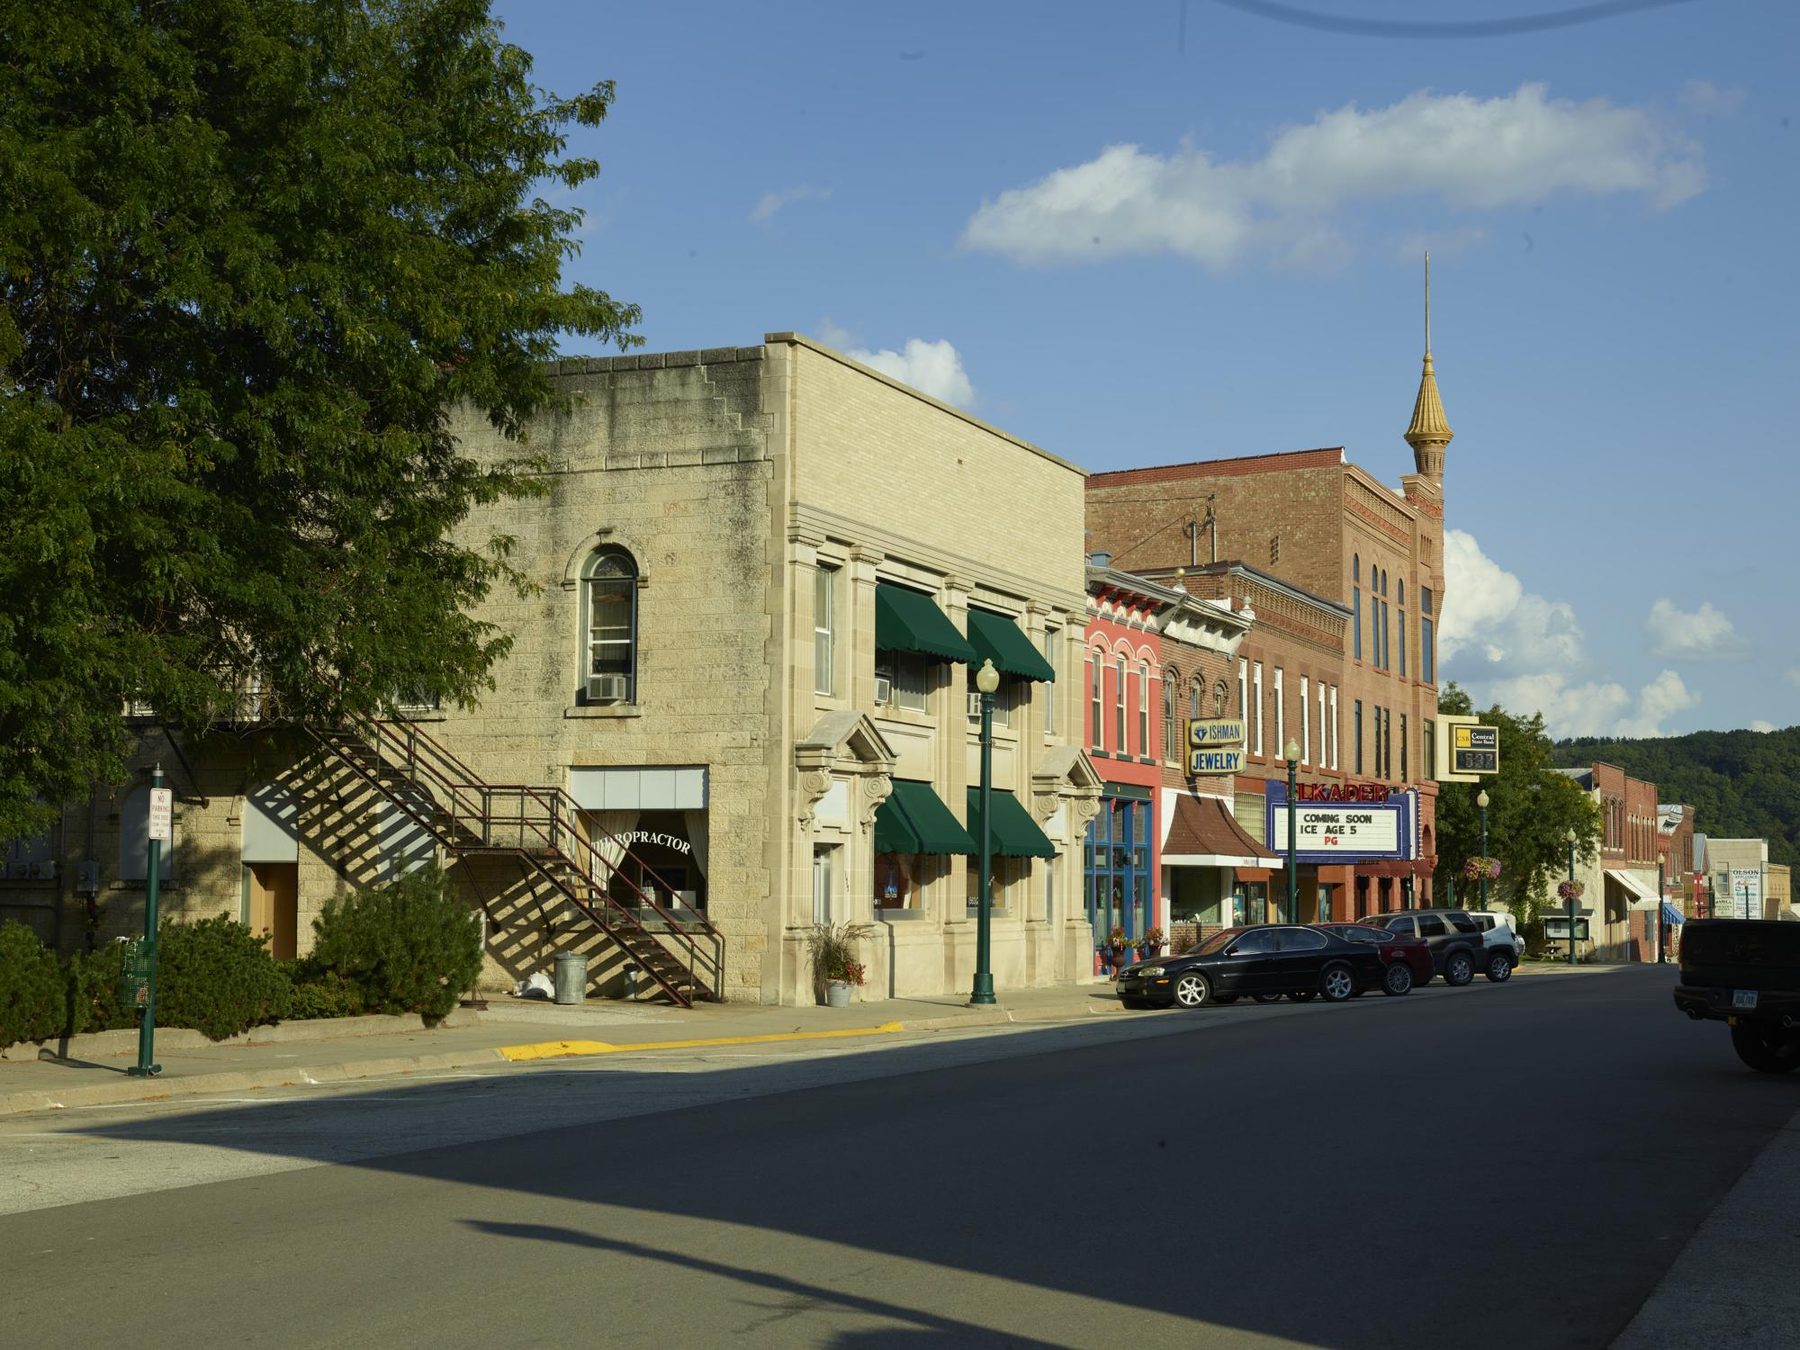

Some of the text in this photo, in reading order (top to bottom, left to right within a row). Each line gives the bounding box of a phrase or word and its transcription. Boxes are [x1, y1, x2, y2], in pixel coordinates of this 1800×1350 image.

[1209, 723, 1240, 740] ISHMAN
[1471, 732, 1495, 740] Central
[1192, 752, 1240, 771] JEWELRY
[1287, 783, 1388, 802] LKADER
[1303, 813, 1372, 824] COMING SOON
[1300, 824, 1358, 835] ICE AGE 5
[1324, 836, 1339, 846] PG
